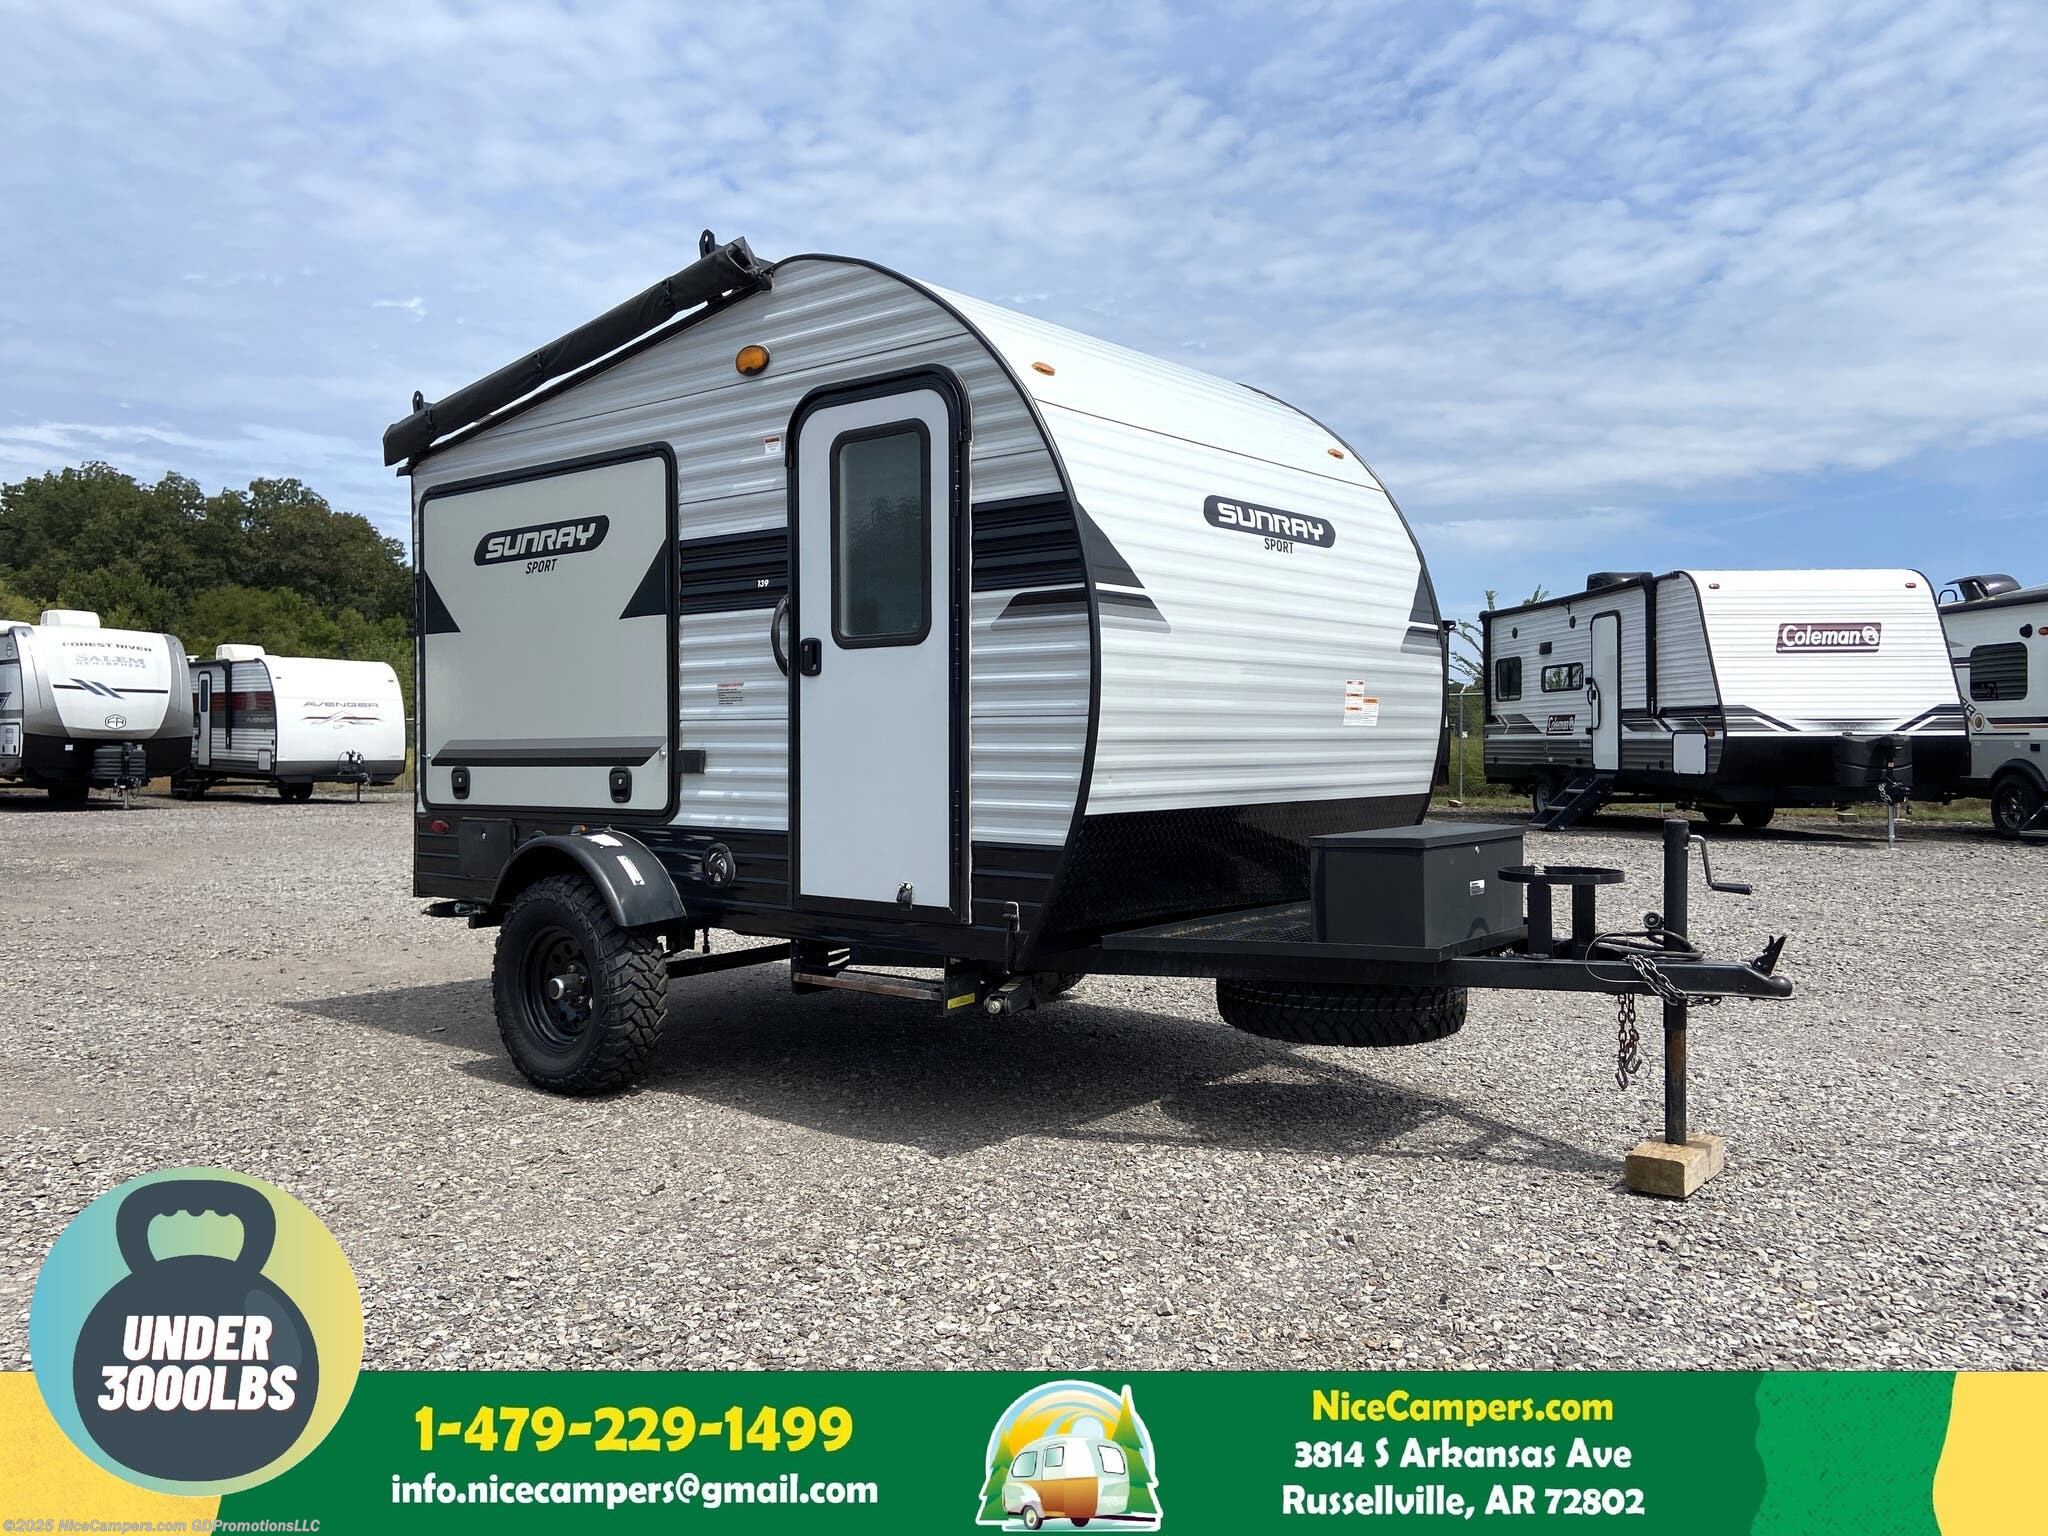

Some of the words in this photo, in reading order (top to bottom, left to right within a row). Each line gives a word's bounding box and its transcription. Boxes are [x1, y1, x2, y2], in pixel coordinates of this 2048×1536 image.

[1216, 501, 1324, 541] SUNRAY
[485, 522, 597, 560] SUNRAY
[1263, 537, 1295, 555] SPORT
[525, 558, 558, 575] SPORT
[757, 579, 769, 588] 139
[1782, 624, 1861, 647] Coleman
[115, 643, 152, 653] RIVER
[303, 700, 380, 709] AVENGER
